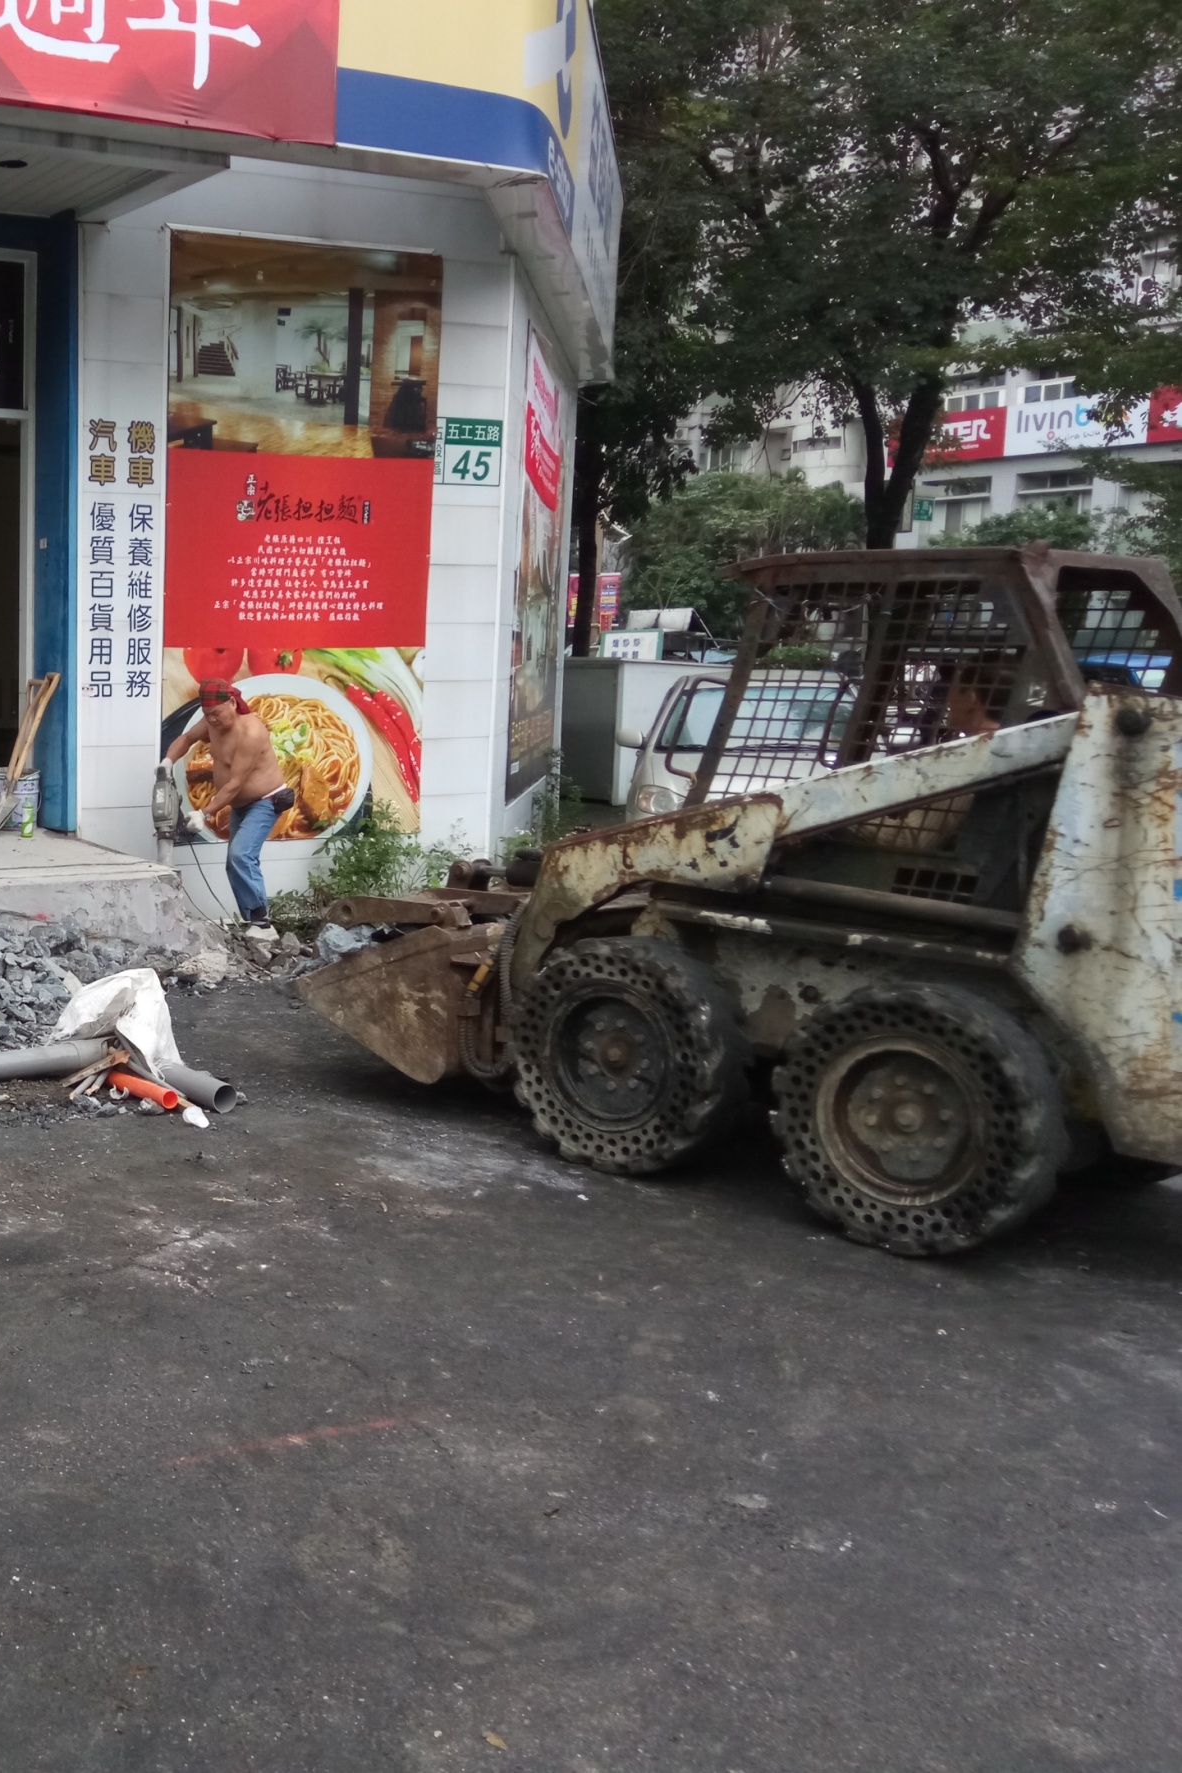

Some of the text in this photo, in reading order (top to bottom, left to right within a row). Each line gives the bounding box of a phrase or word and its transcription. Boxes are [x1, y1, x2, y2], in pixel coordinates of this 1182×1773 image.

[446, 423, 500, 441] 五工五路
[452, 450, 492, 481] 45
[88, 418, 117, 698] 汽車 優質百貨用品
[125, 420, 156, 698] 機車 保養維修服務
